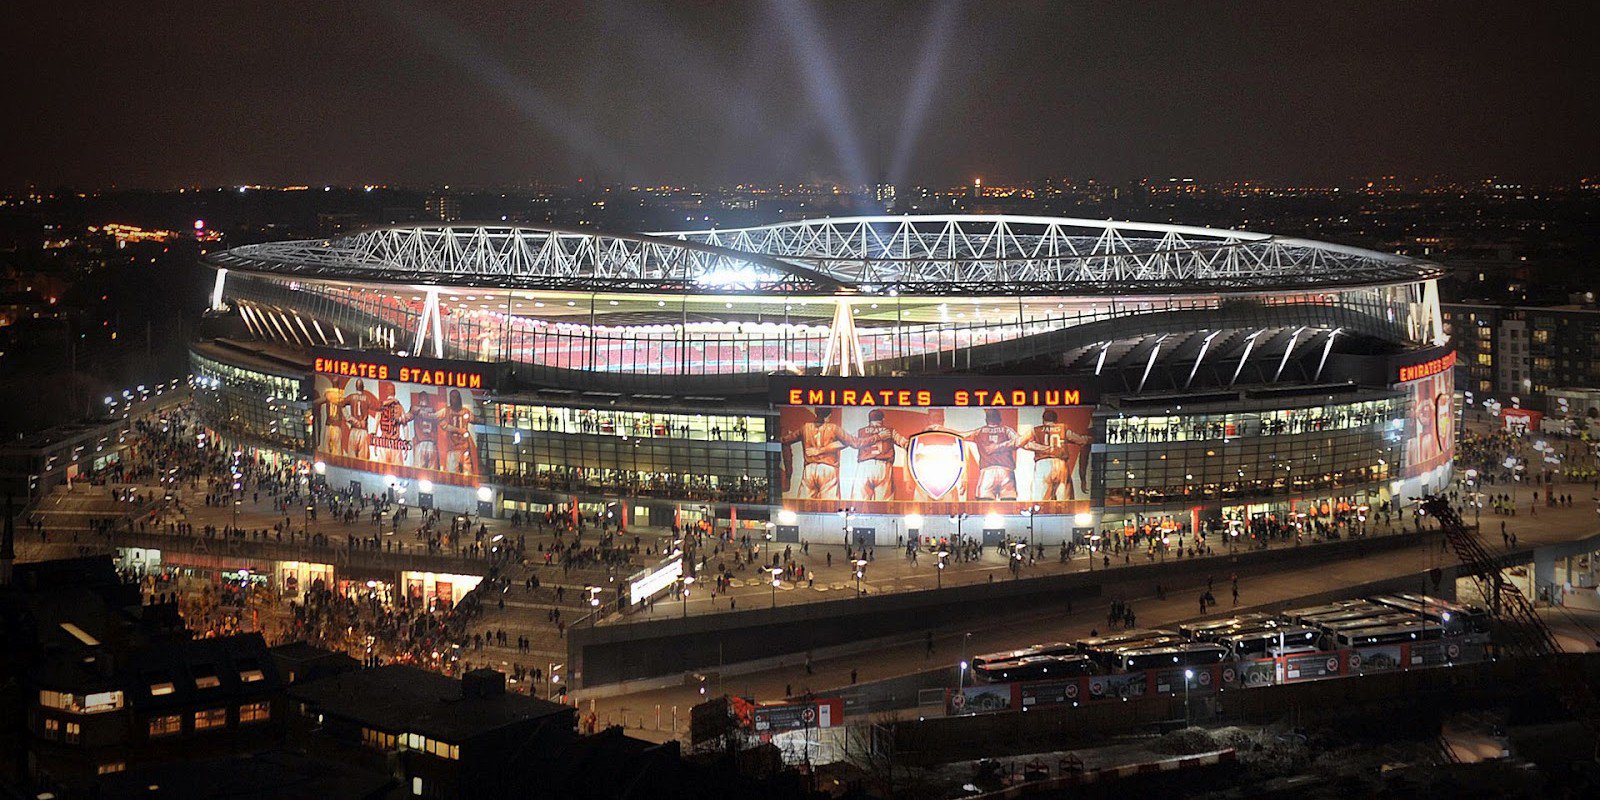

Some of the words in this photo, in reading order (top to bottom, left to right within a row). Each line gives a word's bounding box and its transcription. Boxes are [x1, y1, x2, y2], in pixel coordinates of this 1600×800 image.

[315, 357, 388, 379] EMIRATES
[399, 366, 481, 389] STADIUM
[790, 390, 930, 405] EMIRATES
[955, 391, 1079, 405] STADIUM
